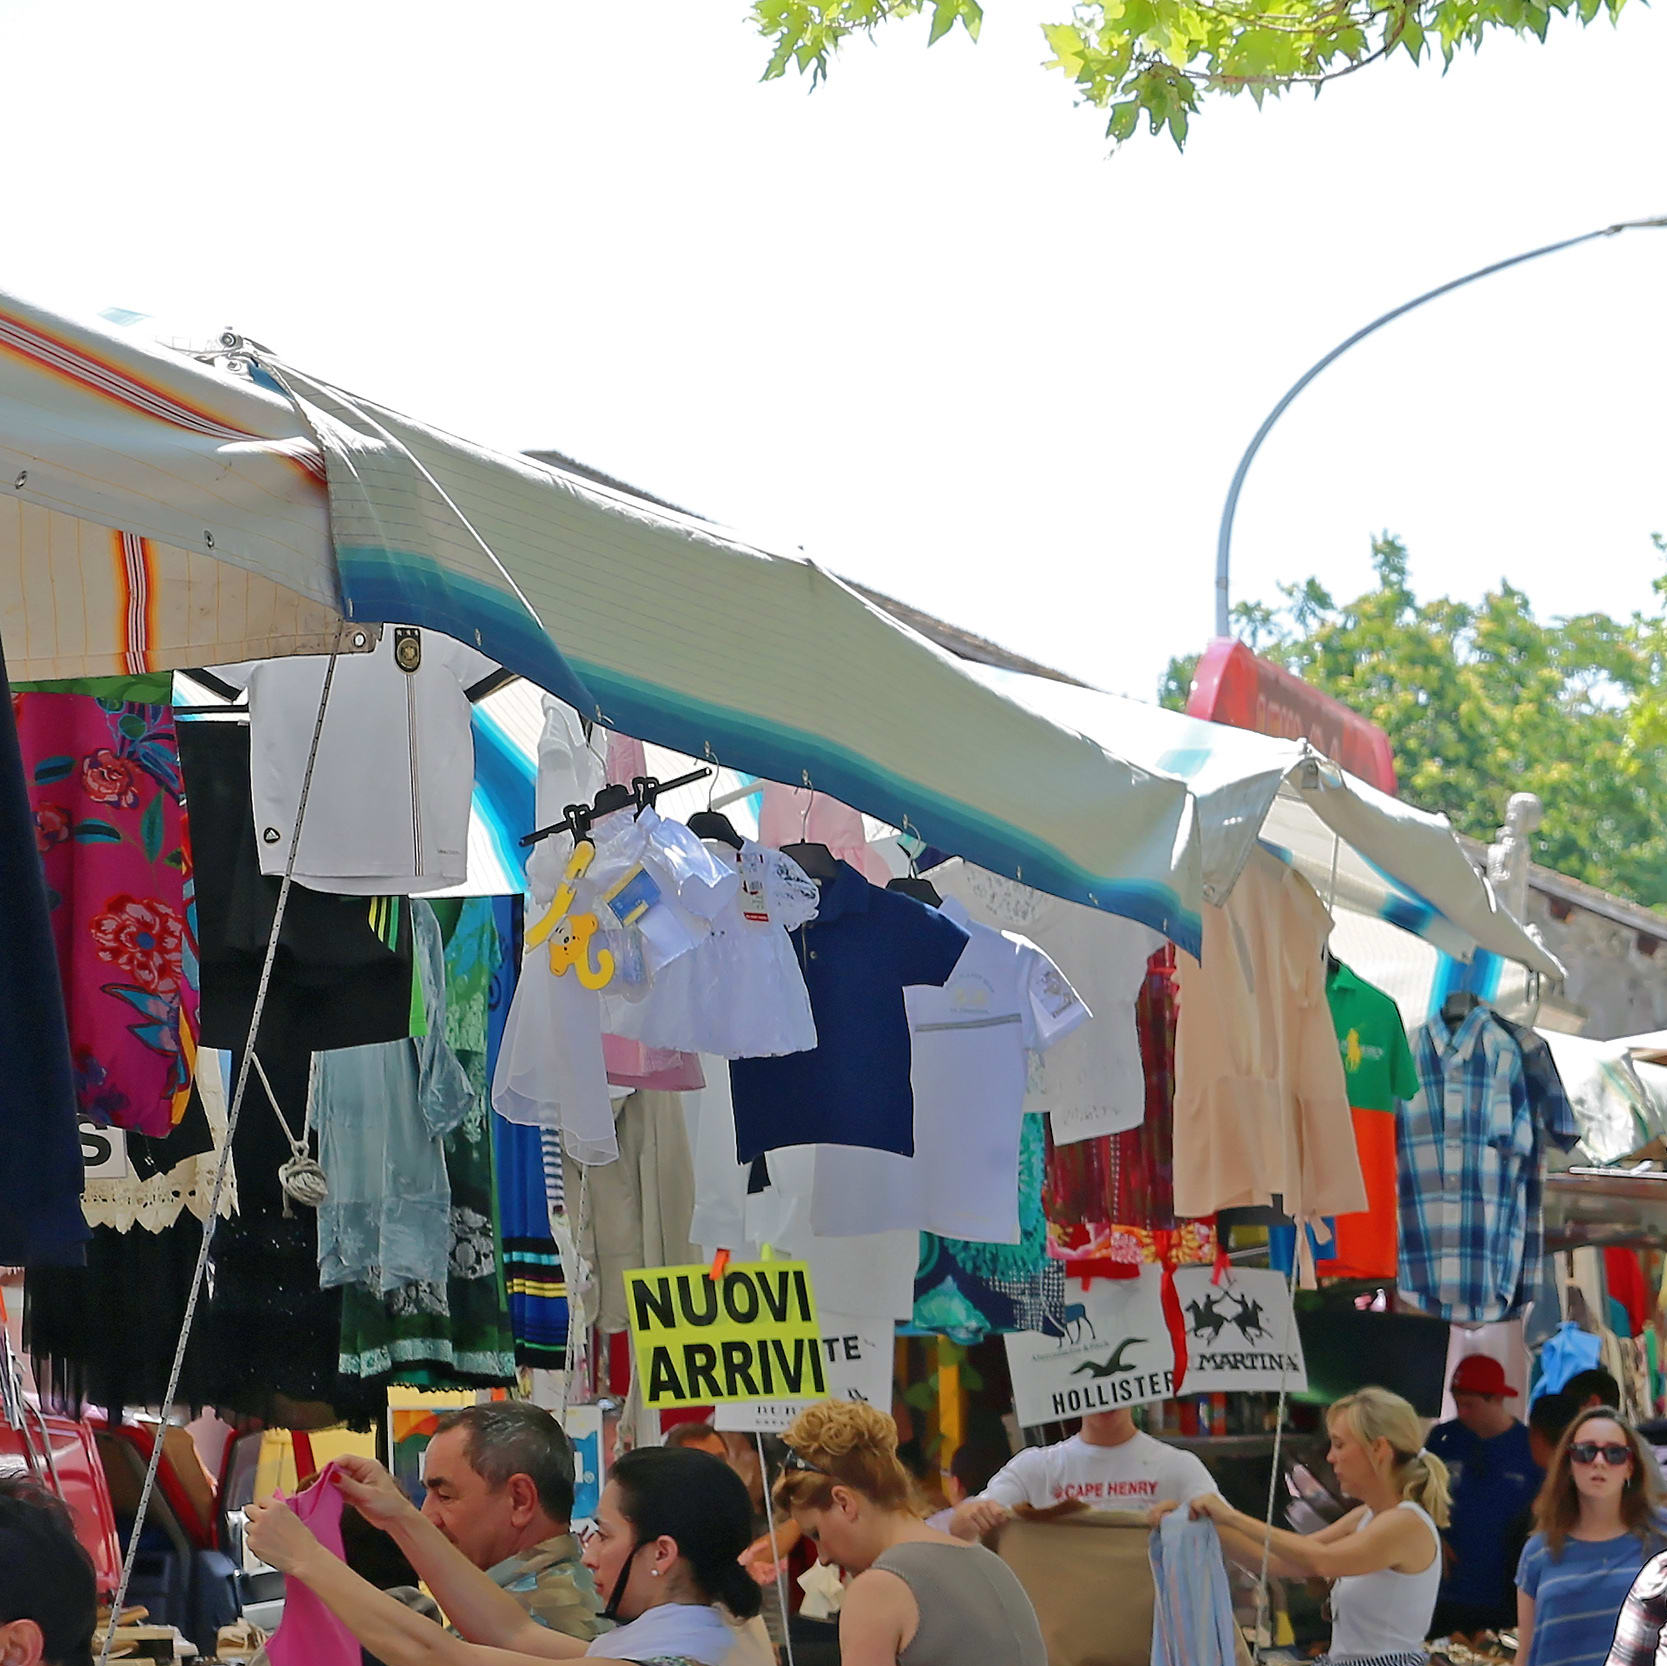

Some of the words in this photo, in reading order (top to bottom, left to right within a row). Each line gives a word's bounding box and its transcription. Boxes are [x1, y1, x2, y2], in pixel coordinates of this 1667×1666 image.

[631, 1270, 812, 1331] NUOVI
[648, 1338, 826, 1402] ARRIVI
[1199, 1352, 1300, 1372] MARTINA
[1065, 1482, 1103, 1498] CAPE
[1107, 1480, 1159, 1497] HENRY
